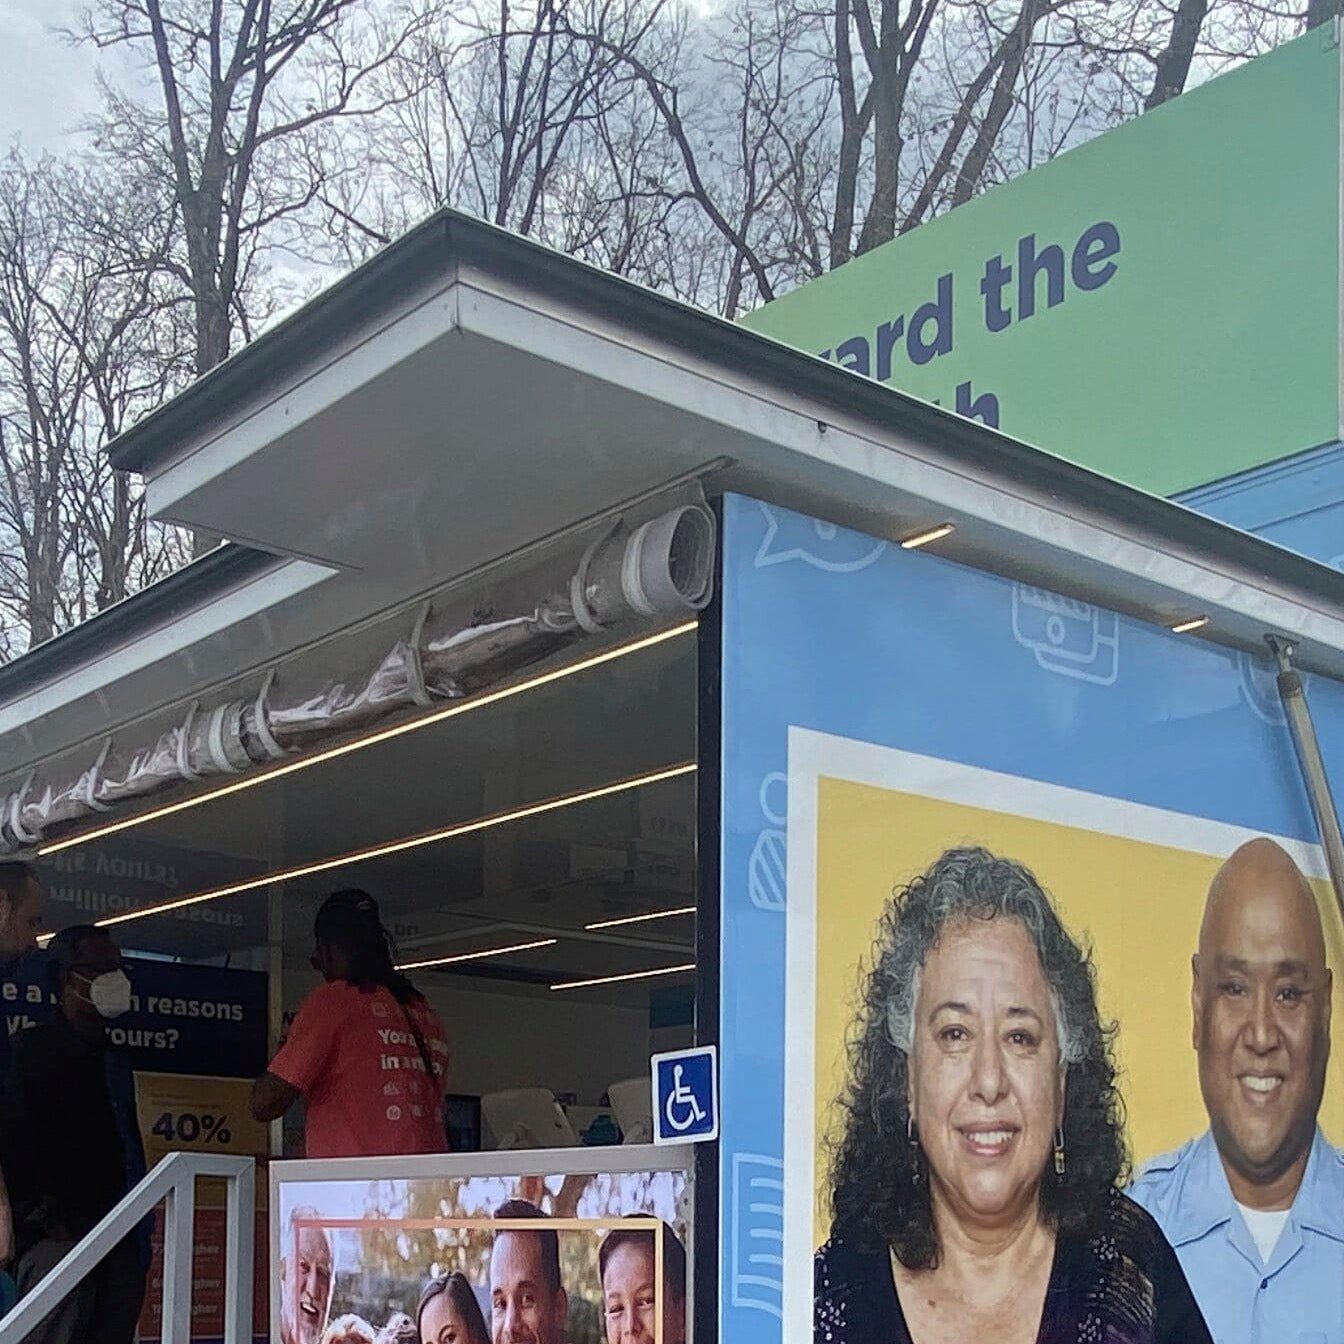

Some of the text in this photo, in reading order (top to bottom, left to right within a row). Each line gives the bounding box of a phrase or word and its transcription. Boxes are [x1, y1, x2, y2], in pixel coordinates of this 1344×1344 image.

[980, 220, 1121, 334] the
[147, 996, 244, 1022] reasons
[105, 1028, 180, 1050] ours?
[152, 1112, 232, 1144] 40%
